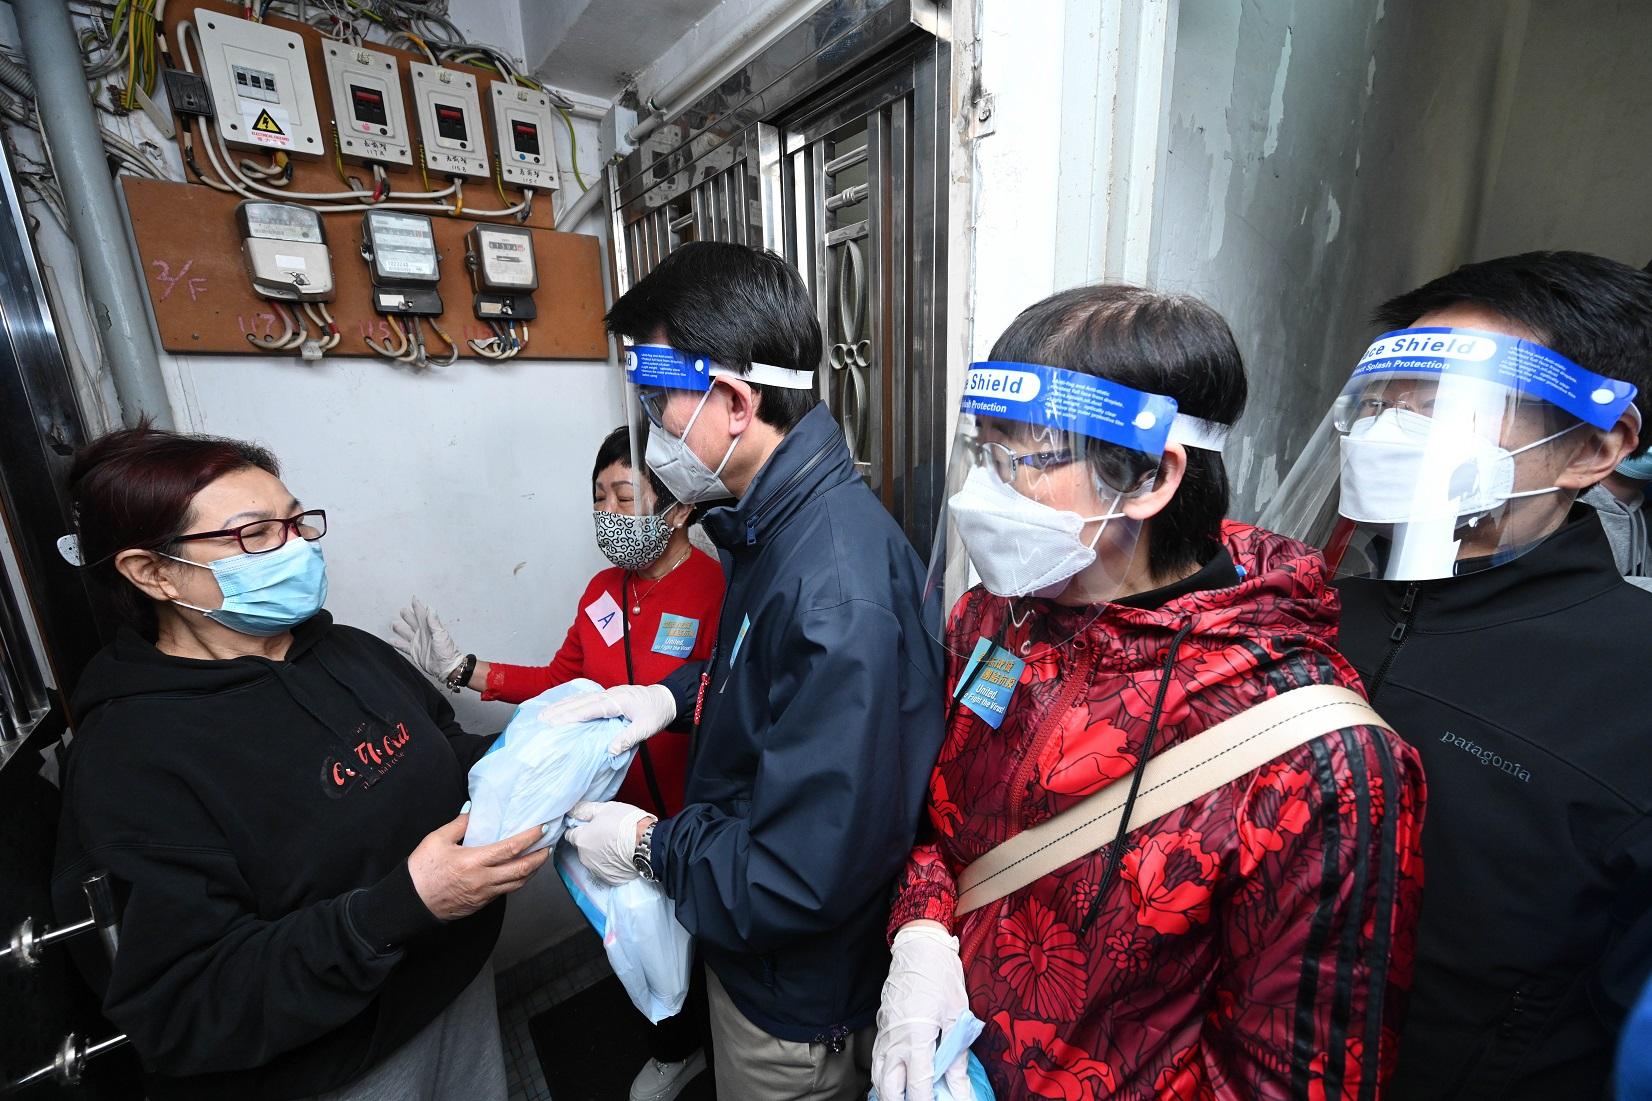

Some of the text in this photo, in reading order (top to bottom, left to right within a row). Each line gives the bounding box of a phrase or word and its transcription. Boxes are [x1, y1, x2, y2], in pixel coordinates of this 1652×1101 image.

[1392, 338, 1477, 354] Shield
[1366, 360, 1391, 372] Splash
[1393, 360, 1450, 370] Protection
[970, 373, 1023, 394] Shield
[972, 400, 1007, 413] Protection
[598, 611, 616, 629] A
[1439, 731, 1531, 783] patagonia
